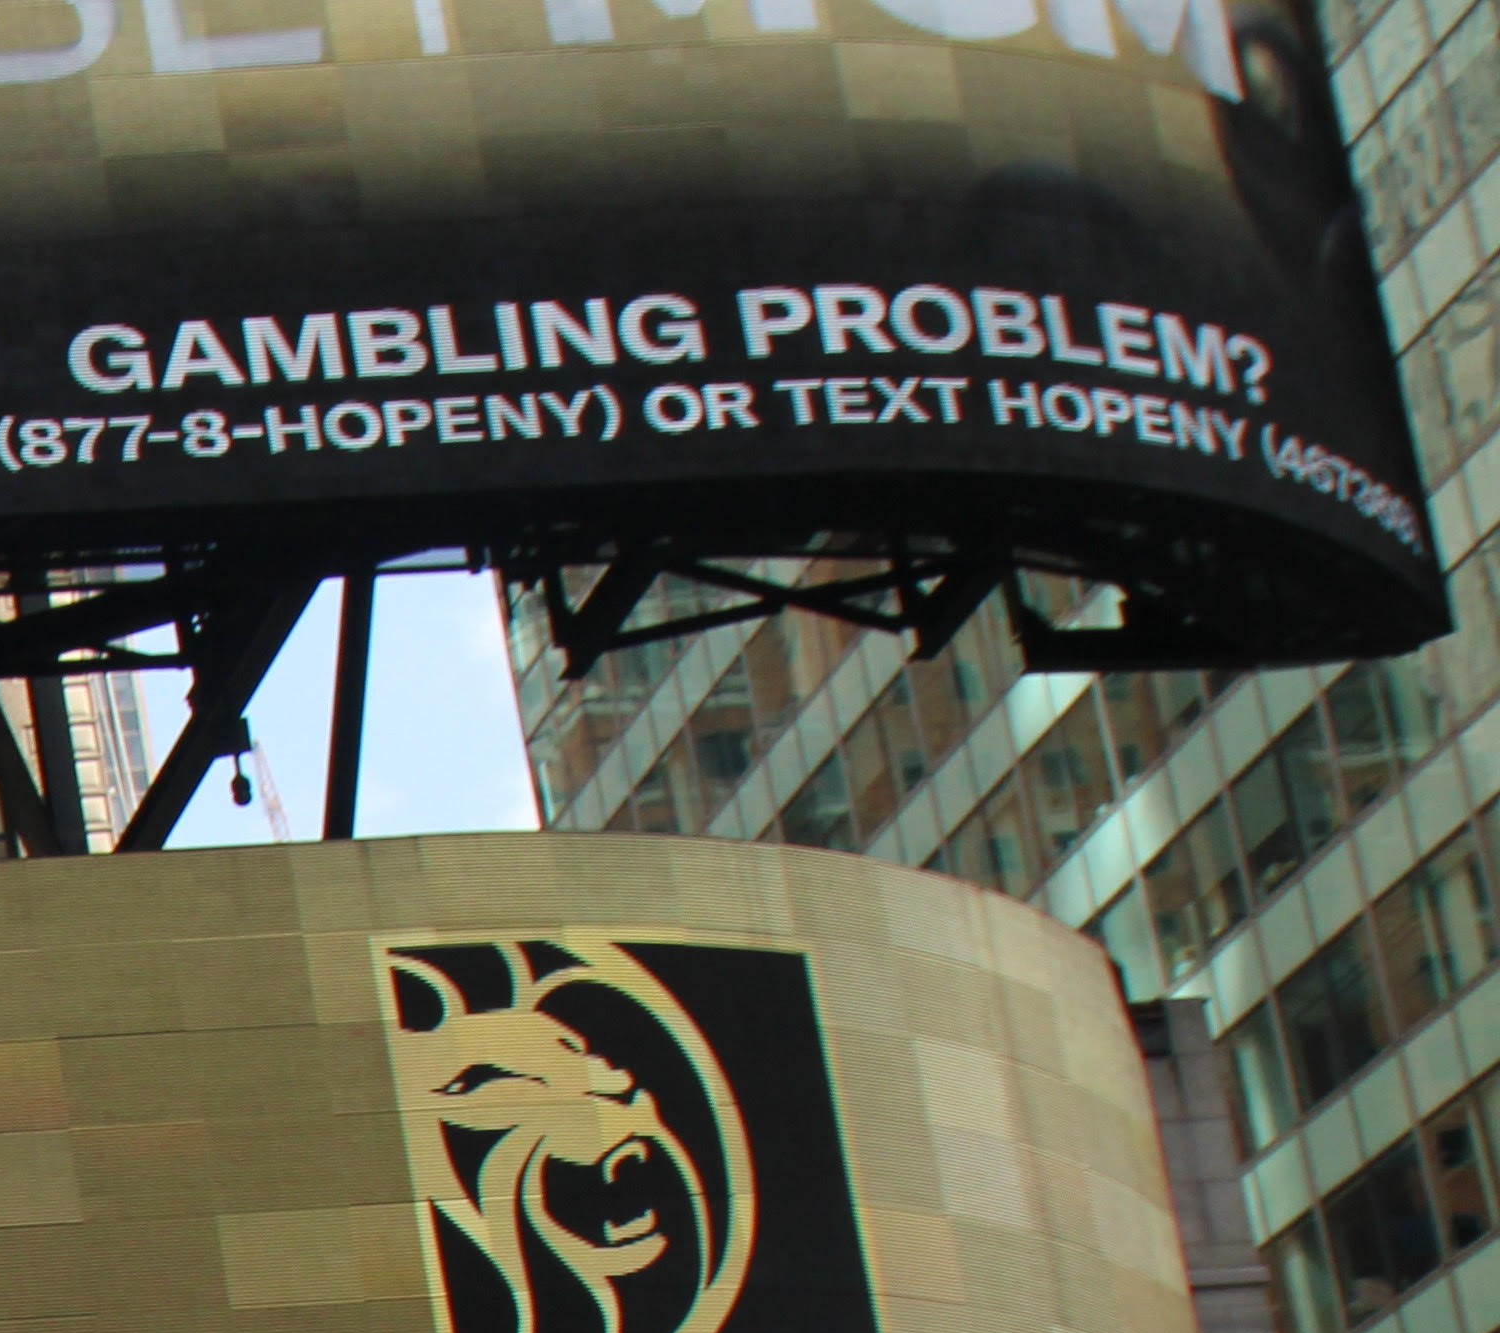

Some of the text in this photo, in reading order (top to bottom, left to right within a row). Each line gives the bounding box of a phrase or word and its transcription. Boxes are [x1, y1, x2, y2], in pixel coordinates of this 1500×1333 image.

[68, 284, 1272, 404] GAMBLING PROBLEM?
[643, 381, 759, 434] OR
[774, 377, 968, 425] TEXT
[989, 379, 1247, 461] HOPENY
